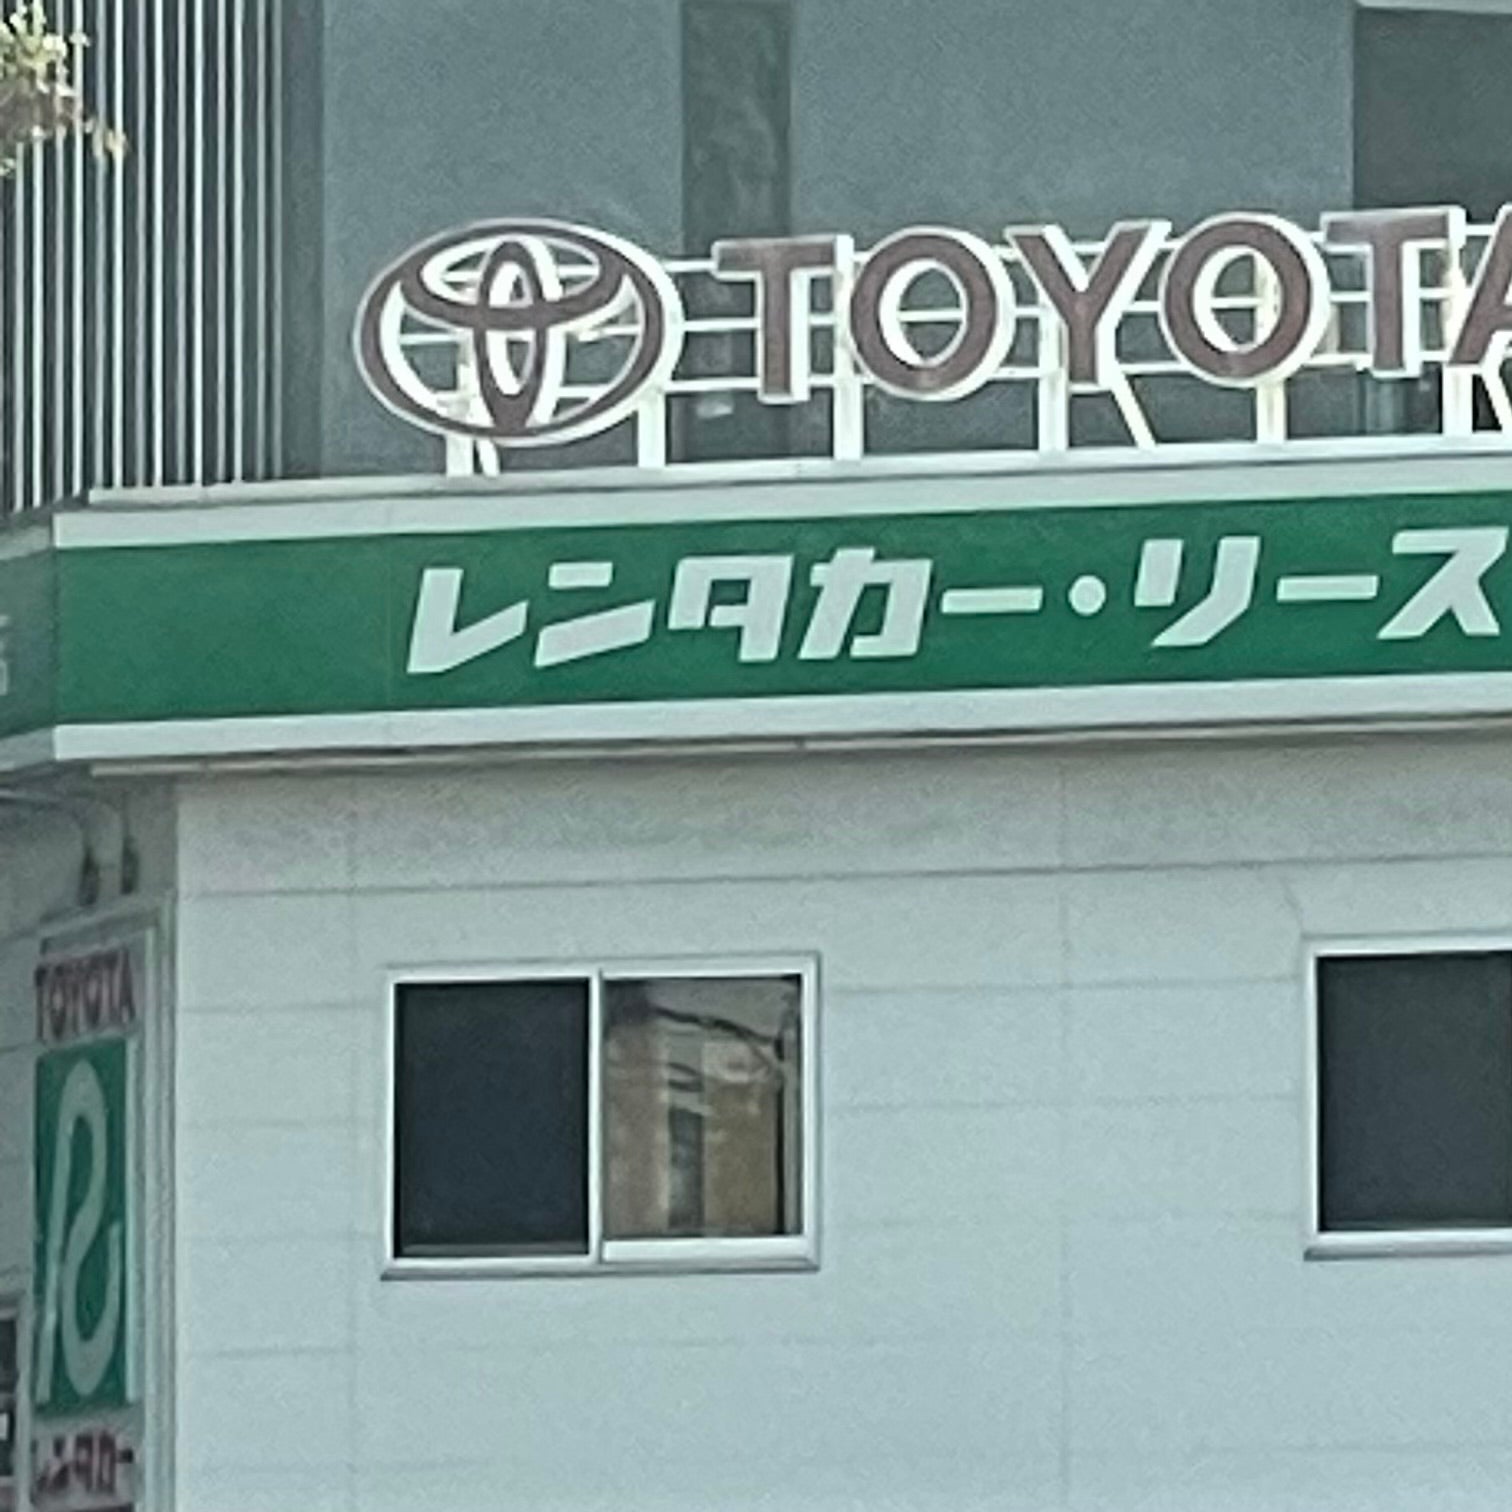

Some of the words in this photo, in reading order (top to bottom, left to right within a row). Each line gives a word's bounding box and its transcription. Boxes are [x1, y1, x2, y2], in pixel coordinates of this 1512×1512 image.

[408, 525, 1510, 674] レンタカー・リース
[34, 948, 136, 1040] TOYOTA
